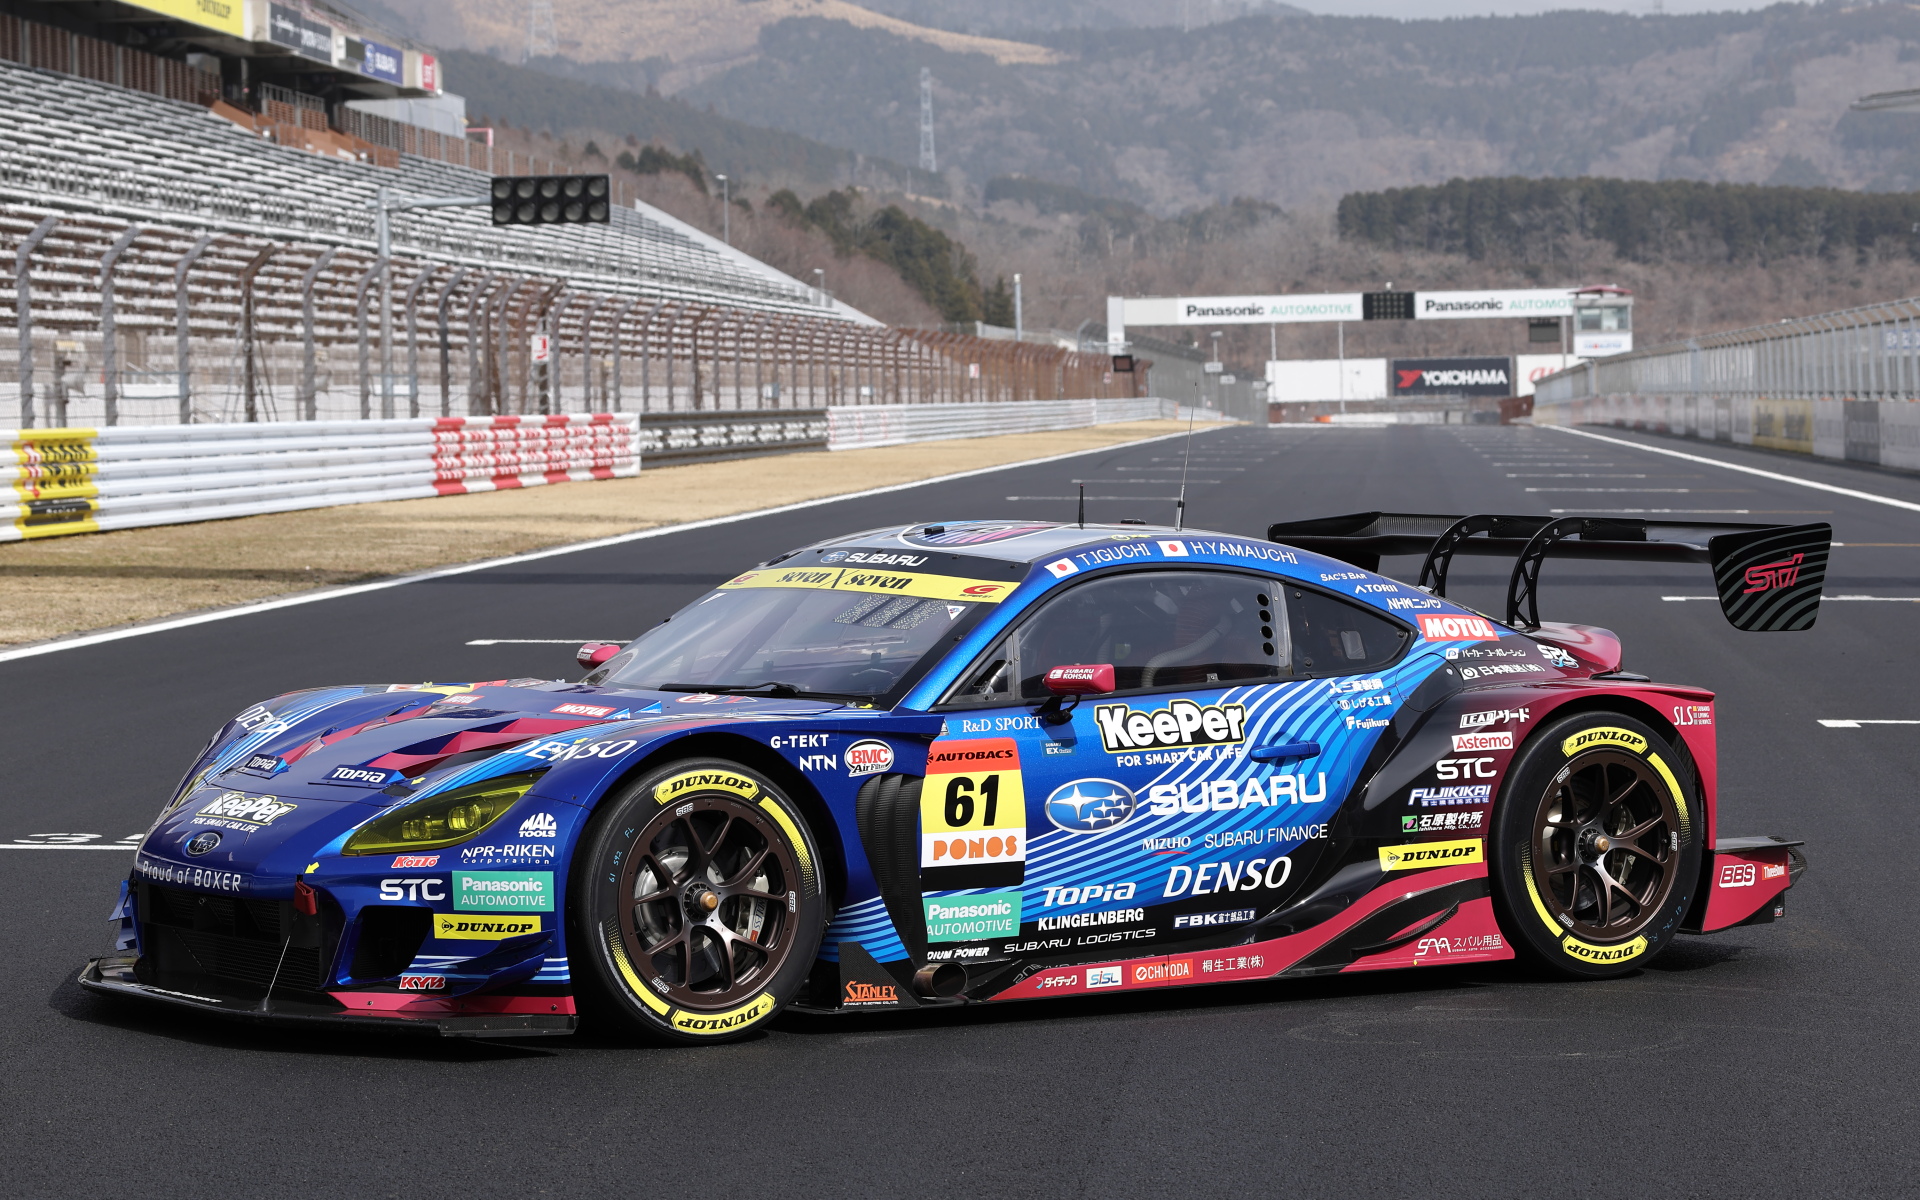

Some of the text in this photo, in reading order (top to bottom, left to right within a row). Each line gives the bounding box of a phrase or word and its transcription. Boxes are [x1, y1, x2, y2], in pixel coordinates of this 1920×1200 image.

[1186, 303, 1354, 317] Panasonic AUTOMOTIVE
[1425, 298, 1504, 311] Panasonic
[1421, 369, 1508, 386] YOKOHAMA
[844, 552, 928, 566] SUBARU
[1076, 543, 1151, 567] T.IGUCHI
[1190, 541, 1299, 565] H.YAMAUCHI
[776, 571, 913, 590] seven seven
[1425, 617, 1494, 638] MOTUL
[555, 704, 610, 717] MOTUL
[1352, 695, 1392, 709] しげる工業
[1356, 718, 1390, 730] Fujikura
[1673, 706, 1693, 725] SLS
[962, 719, 992, 733] R&D
[995, 716, 1042, 731] SPORT
[1099, 701, 1245, 748] KeePer
[770, 734, 829, 748] G-TEKT
[1456, 736, 1511, 750] Astemo
[1574, 731, 1644, 748] DUNLOP
[799, 754, 837, 772] NTN
[851, 749, 888, 764] BMC
[936, 750, 1014, 762] AUTOBACS
[1116, 747, 1242, 768] FOR SMART CAR LIFE
[852, 764, 870, 773] Air
[1436, 757, 1498, 780] STC
[670, 774, 753, 793] DUNLOP
[944, 774, 1000, 828] 61
[1149, 771, 1327, 816] SUBARU
[1408, 784, 1492, 806] FUJIKIKAI
[519, 813, 557, 831] MAC
[1418, 811, 1484, 827] 石原製作所
[518, 829, 557, 838] TOOLS
[1204, 823, 1328, 849] SUBARU FINANCE
[460, 844, 554, 858] NPR-RIKEN
[933, 835, 1017, 861] PONOS
[1142, 836, 1191, 850] MIZUHO
[463, 857, 550, 865] Corporation
[1402, 846, 1476, 862] DUNLOP
[142, 861, 241, 892] Proud of BOXER
[462, 876, 543, 892] Panasonic
[1162, 856, 1292, 898] DENSO
[1719, 863, 1756, 888] BBS
[379, 878, 446, 901] STC
[461, 895, 546, 906] AUTOMOTIVE
[928, 899, 1012, 920] Panasonic
[456, 922, 533, 933] DUNLOP
[927, 918, 1013, 937] AUTOMOTIVE
[1037, 907, 1145, 931] KLINGELNBERG
[1174, 913, 1218, 928] FBK
[1003, 928, 1156, 954] SUBARU LOGISTICS
[1453, 934, 1502, 948] スバル用品
[953, 946, 990, 959] POWER
[1567, 943, 1635, 960] DUNLOP
[1148, 962, 1190, 979] CHIYODA
[1202, 955, 1264, 973] 桐生工業(株)
[399, 976, 446, 990] KYB
[652, 976, 671, 993] BBS
[1044, 975, 1077, 988] ダイテック
[844, 981, 899, 1002] STANLEY
[678, 1005, 761, 1030] DUNLOP
